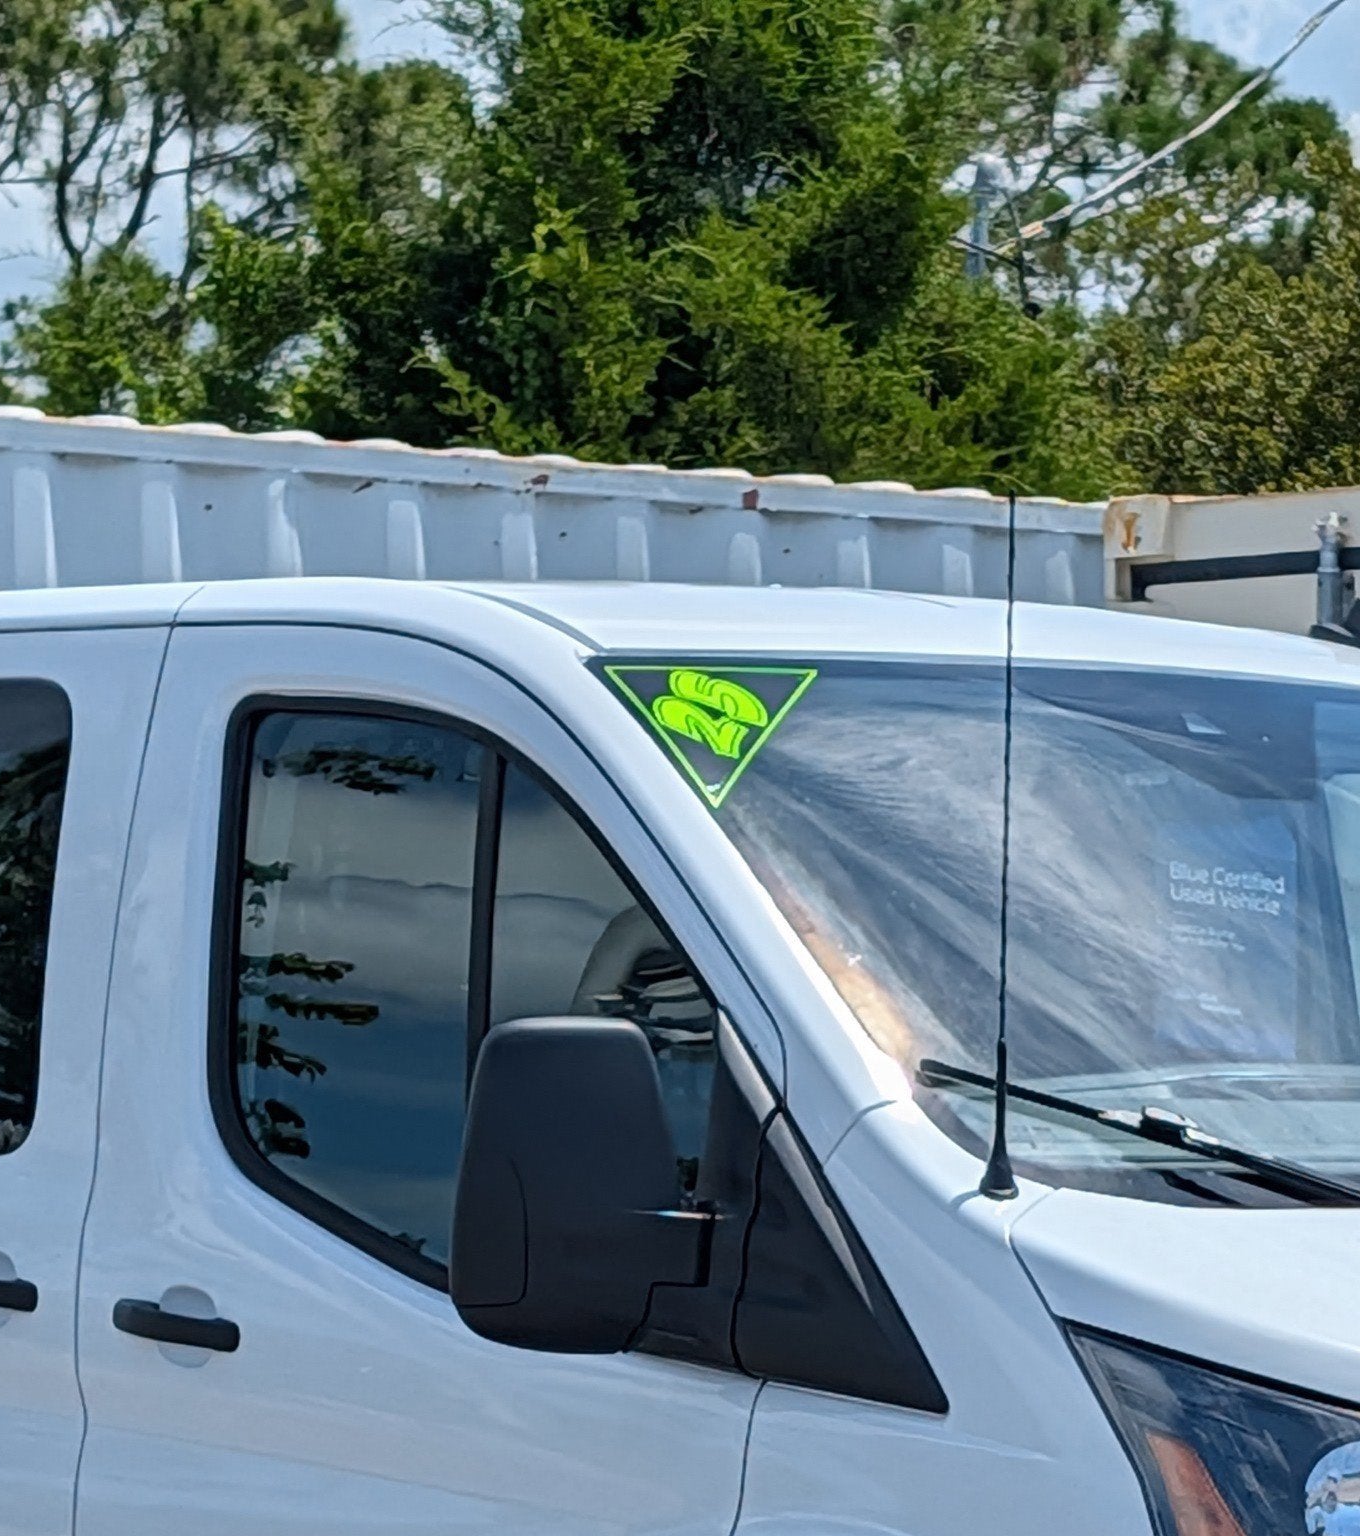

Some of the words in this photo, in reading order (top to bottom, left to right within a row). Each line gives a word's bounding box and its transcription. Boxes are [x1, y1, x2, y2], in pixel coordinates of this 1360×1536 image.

[652, 669, 769, 759] 25
[1169, 861, 1209, 884] Blue
[1169, 883, 1215, 904] Used
